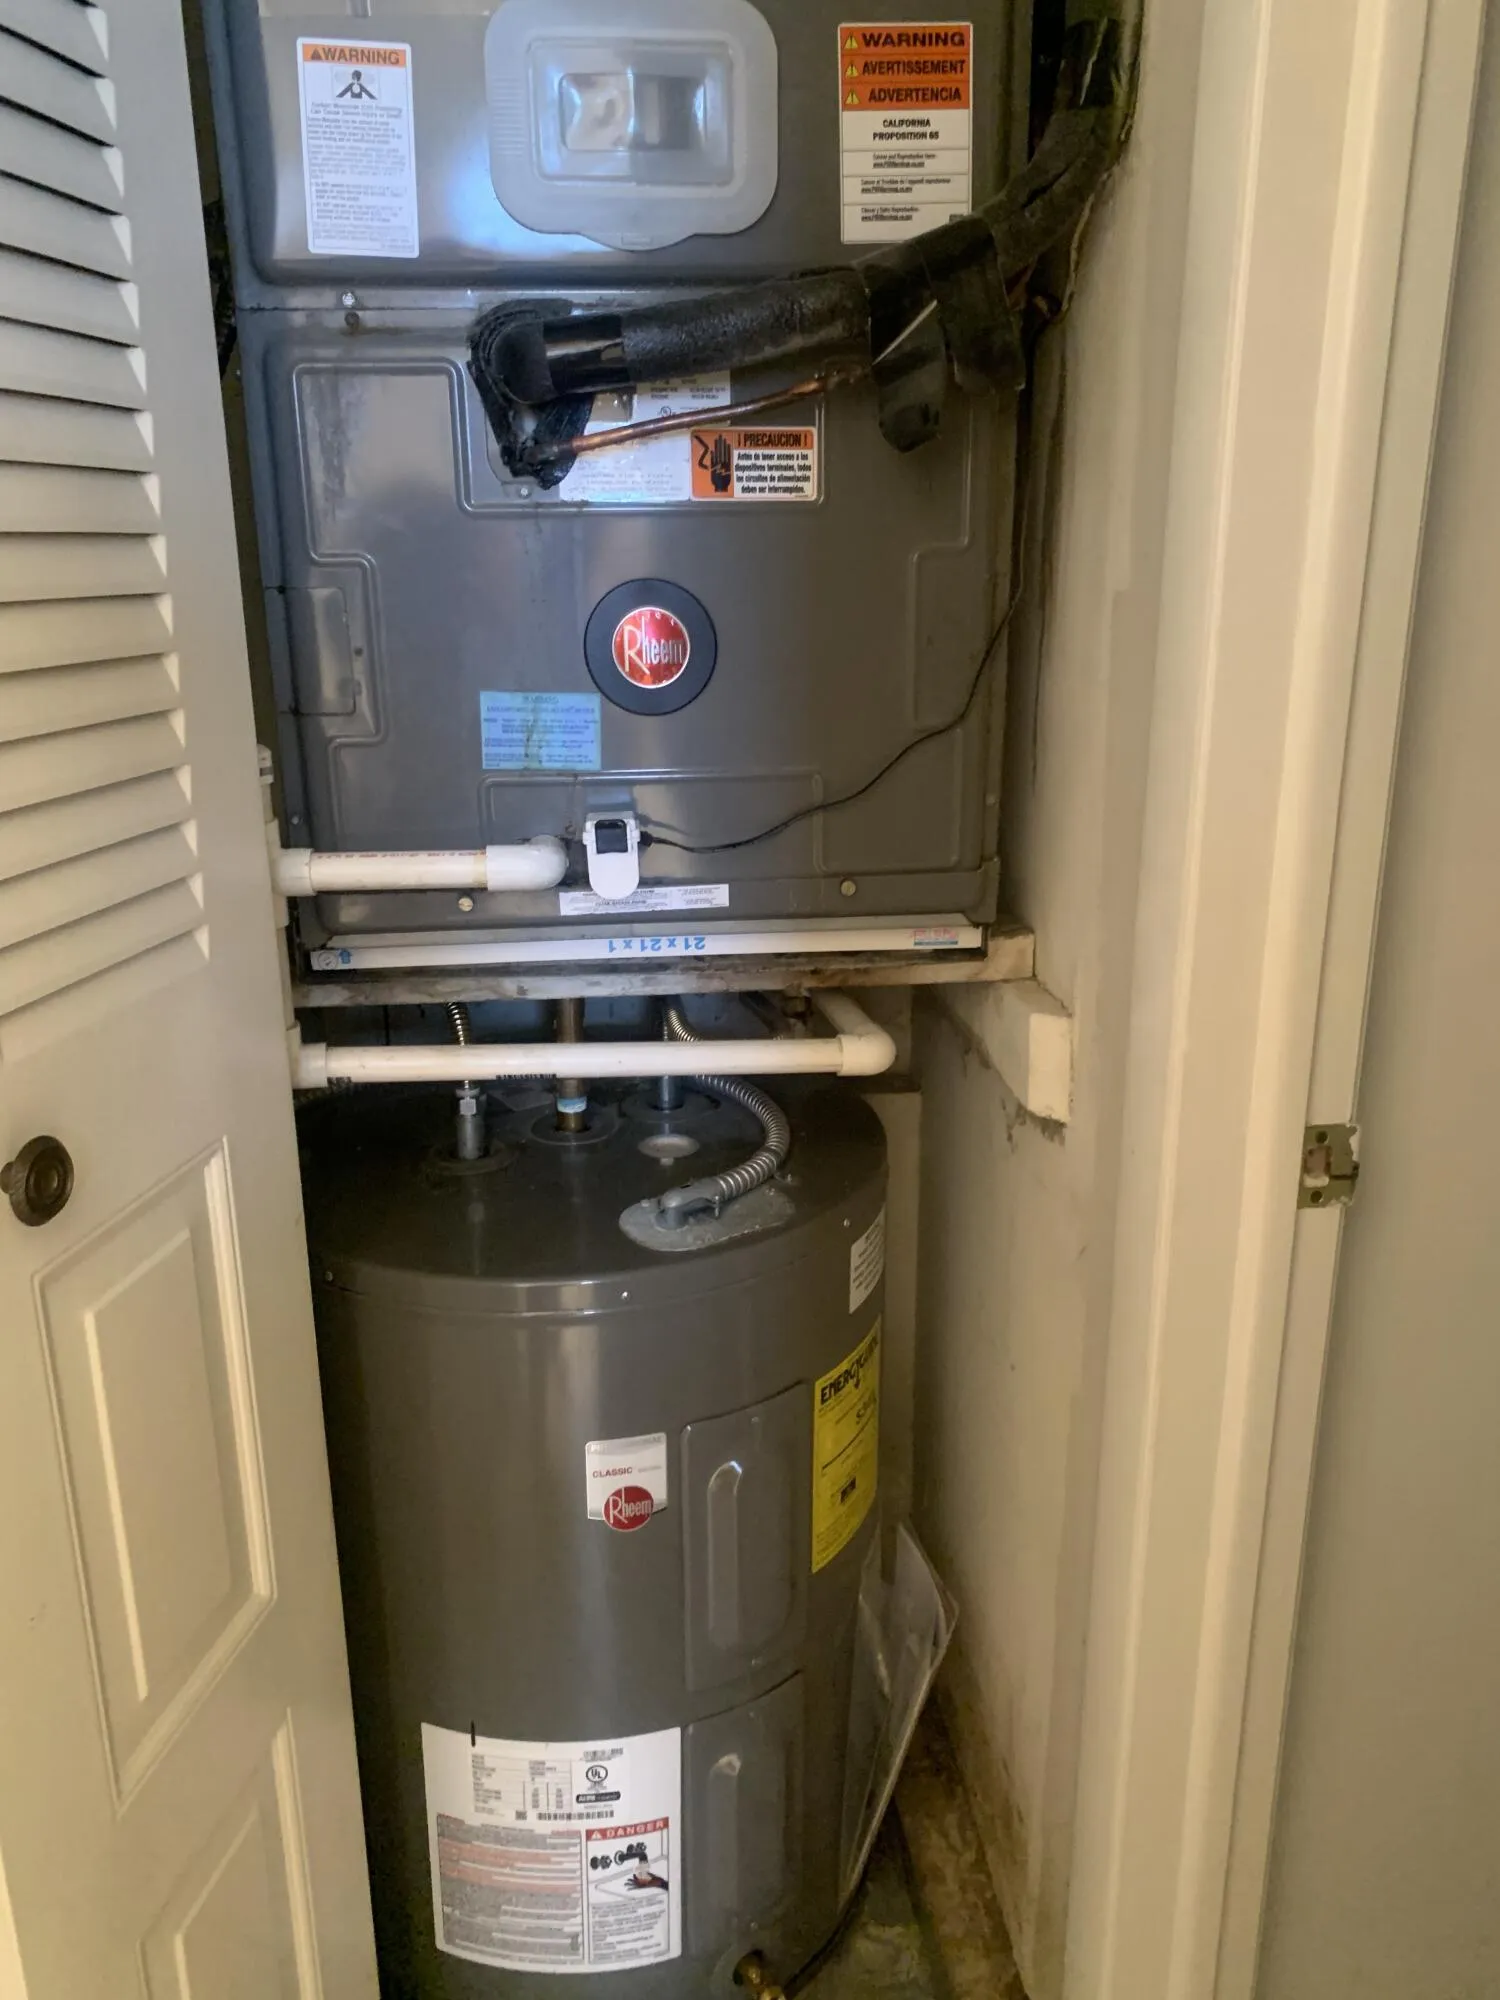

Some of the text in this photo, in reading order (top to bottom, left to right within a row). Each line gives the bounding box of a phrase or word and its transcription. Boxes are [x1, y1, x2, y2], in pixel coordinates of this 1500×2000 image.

[862, 32, 965, 48] WARNING
[322, 47, 400, 65] WARNING
[862, 59, 965, 75] AVERTISSEMENT
[868, 87, 962, 103] ADVERTENCIA
[882, 118, 931, 128] CALIFORNIA
[872, 131, 940, 141] PROPOSITION 65
[622, 615, 683, 675] Rheem
[608, 939, 617, 953] 1
[640, 937, 662, 953] 21
[684, 936, 706, 951] 21
[592, 1466, 633, 1479] CLASSIC
[608, 1486, 653, 1525] Rheem
[606, 1820, 665, 1839] DANGER
